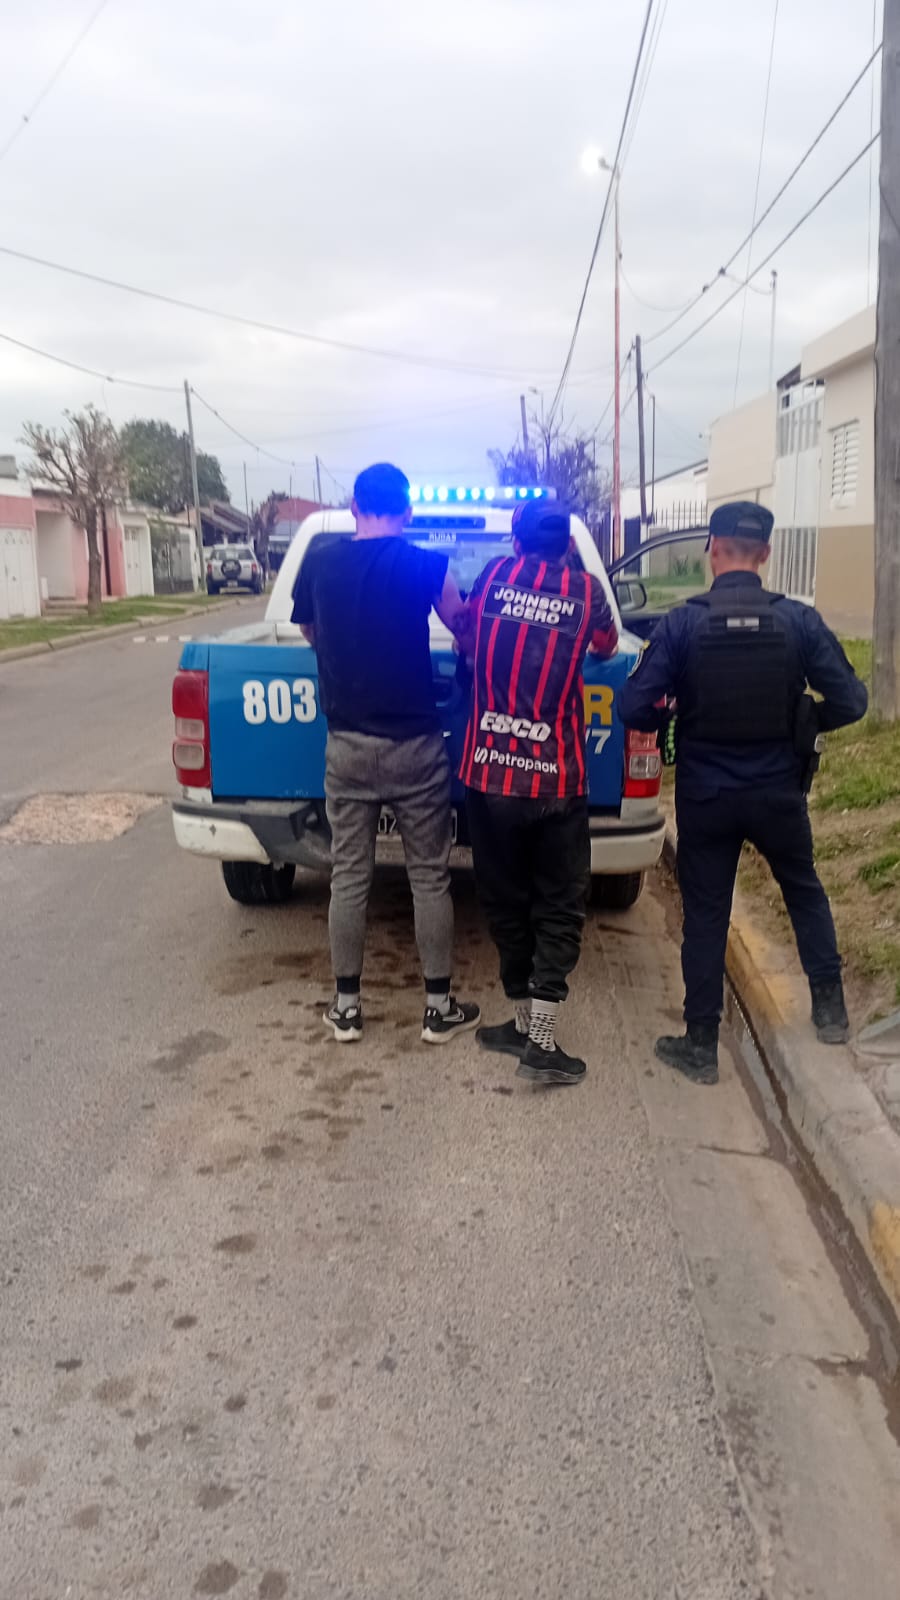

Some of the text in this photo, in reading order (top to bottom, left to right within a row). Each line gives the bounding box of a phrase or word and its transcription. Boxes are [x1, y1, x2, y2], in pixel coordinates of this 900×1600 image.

[494, 587, 575, 616] JOHNSON
[501, 603, 561, 624] ACERO
[242, 678, 317, 725] 803
[479, 711, 552, 742] ESCO
[489, 750, 558, 774] Petropack
